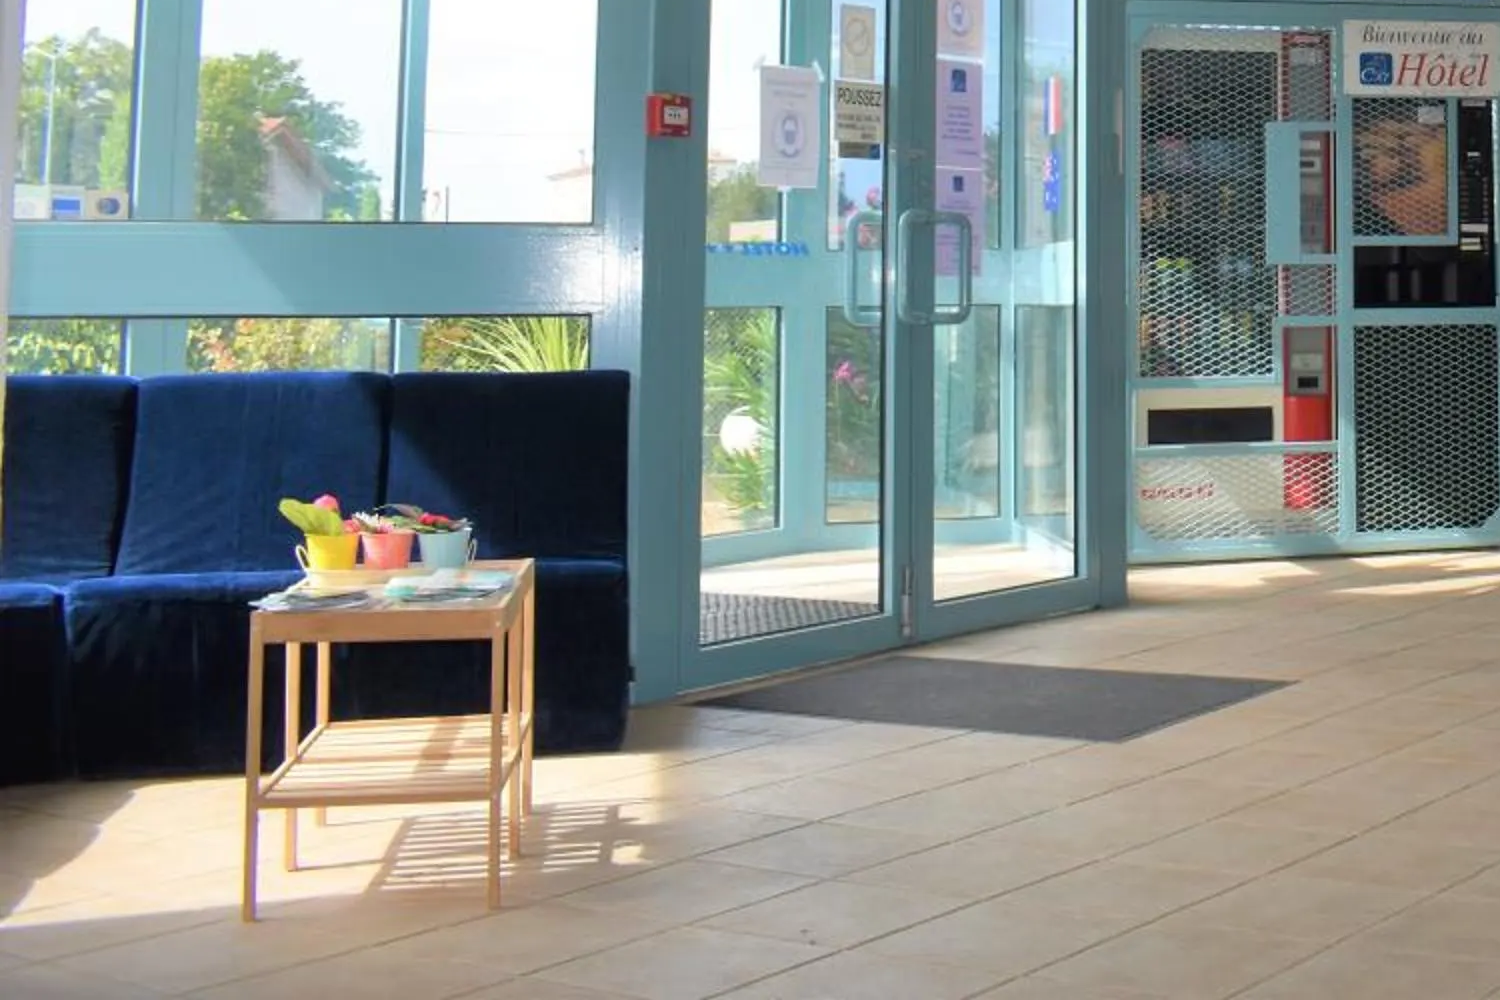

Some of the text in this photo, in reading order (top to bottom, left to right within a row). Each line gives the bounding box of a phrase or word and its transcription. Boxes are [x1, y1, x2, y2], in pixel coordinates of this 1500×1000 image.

[1362, 23, 1451, 43] Bienvenue
[1396, 52, 1489, 87] Hôtel
[837, 86, 882, 107] POUSSEZ
